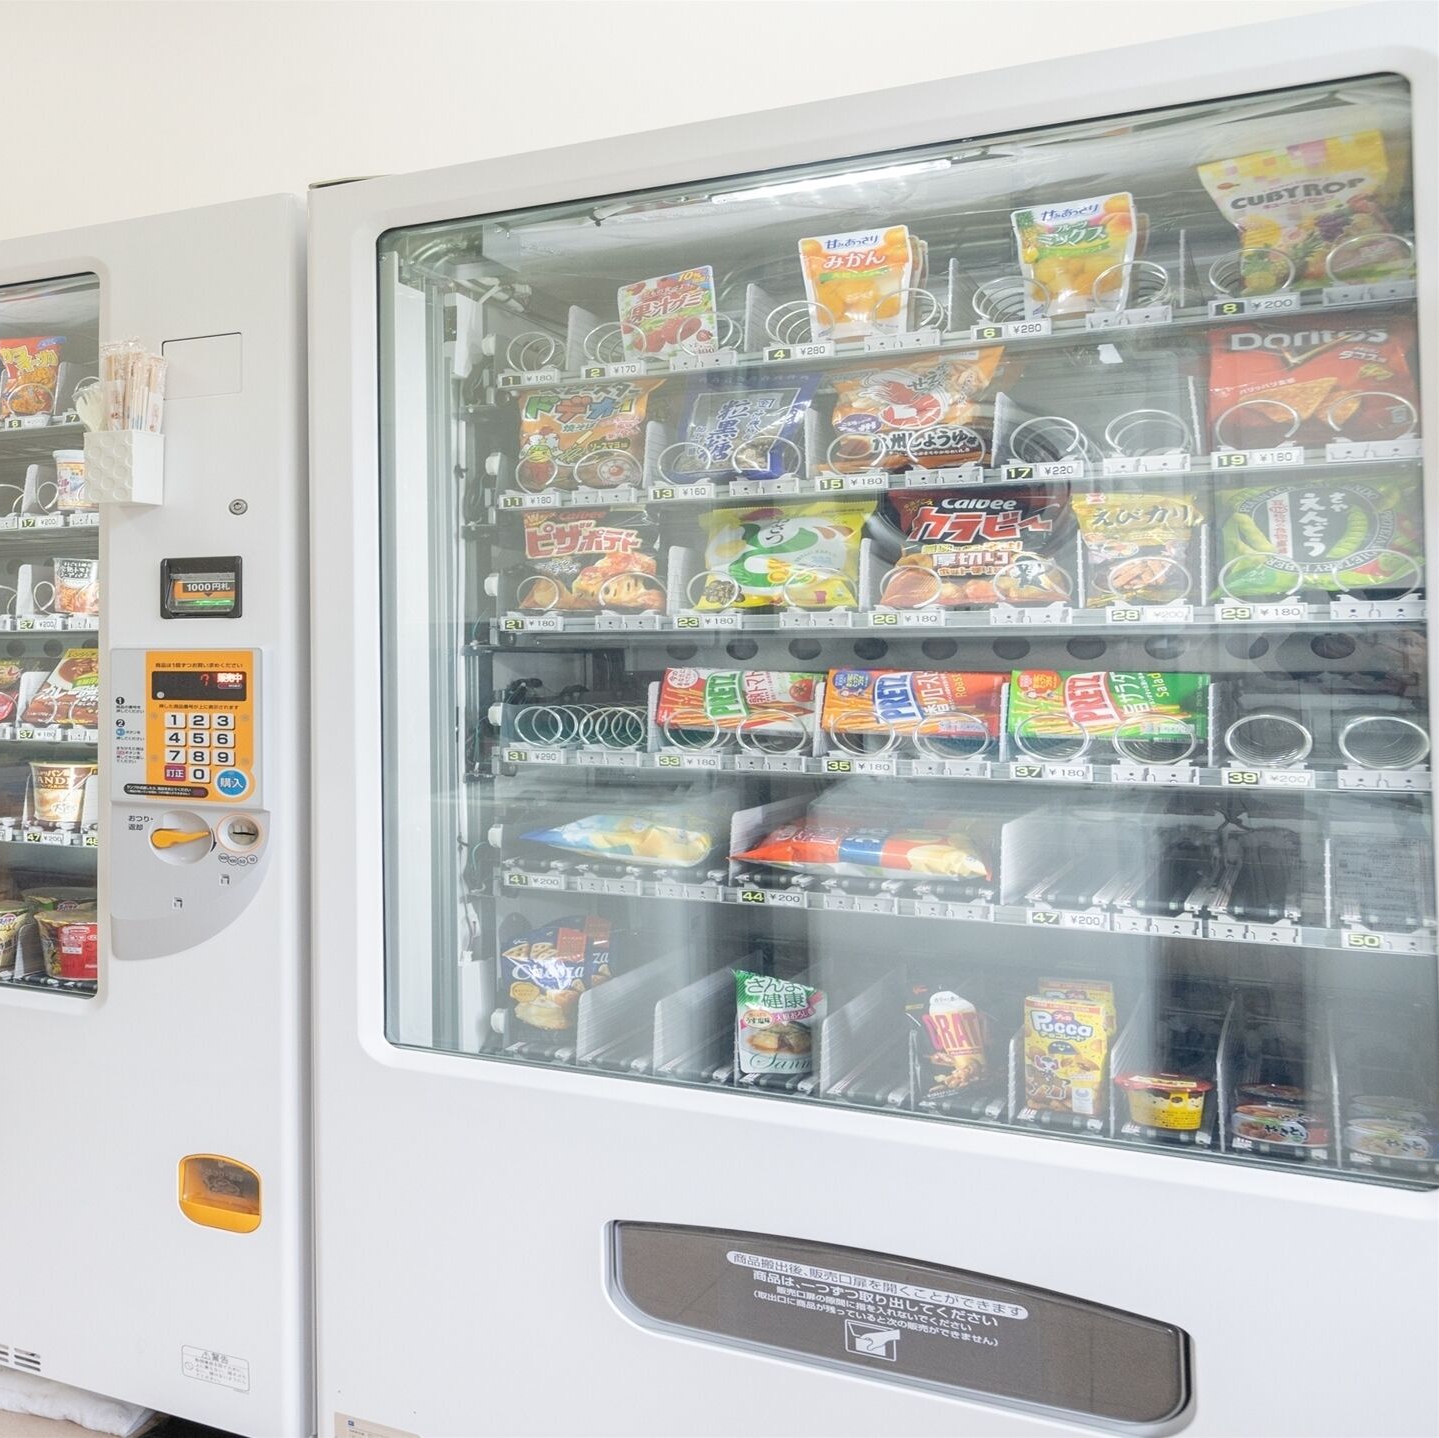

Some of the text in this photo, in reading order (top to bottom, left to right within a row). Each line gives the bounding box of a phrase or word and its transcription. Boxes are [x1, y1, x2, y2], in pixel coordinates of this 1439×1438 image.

[1231, 177, 1365, 209] CUBYROP
[1038, 226, 1107, 246] ミックス
[823, 251, 885, 268] みかん
[631, 292, 703, 321] 果汁グミ
[1253, 299, 1292, 309] ¥200
[1014, 324, 1041, 333] ¥280
[1231, 329, 1388, 350] Doritos
[799, 346, 825, 355] ¥280
[614, 365, 636, 373] ¥170
[526, 374, 552, 382] ¥180
[524, 395, 634, 422] ドデカイ
[1261, 453, 1292, 461] ¥180
[1045, 466, 1073, 474] ¥220
[851, 477, 882, 486] ¥180
[683, 487, 706, 496] ¥160
[530, 496, 551, 504] ¥180
[941, 498, 1017, 510] Calbee
[907, 507, 1053, 542] カラビー
[1299, 493, 1330, 556] えんどう
[525, 520, 641, 559] ピザポテト
[187, 582, 231, 592] 1000円札
[1153, 610, 1184, 620] ¥200
[1260, 606, 1301, 617] ¥180
[529, 619, 554, 628] ¥180
[705, 617, 734, 625] ¥180
[905, 614, 937, 623] ¥180
[952, 674, 967, 697] Roast
[1147, 672, 1169, 697] Salad
[710, 674, 743, 716] PRETZ
[877, 675, 916, 720] PRETZ
[1068, 675, 1114, 720] PRETZ
[170, 715, 229, 726] 1 2 3
[169, 733, 228, 744] 4 5 6
[169, 751, 229, 763] 7 8 9
[858, 763, 890, 771] ¥180
[1049, 768, 1084, 777] ¥180
[166, 769, 184, 778] 訂正
[193, 769, 205, 780] 0
[1272, 775, 1306, 783] ¥200
[220, 777, 244, 788] 購入
[770, 894, 800, 902] ¥200
[1070, 915, 1100, 926] ¥200
[763, 993, 806, 1009] 健康
[1031, 1010, 1092, 1037] Pucca
